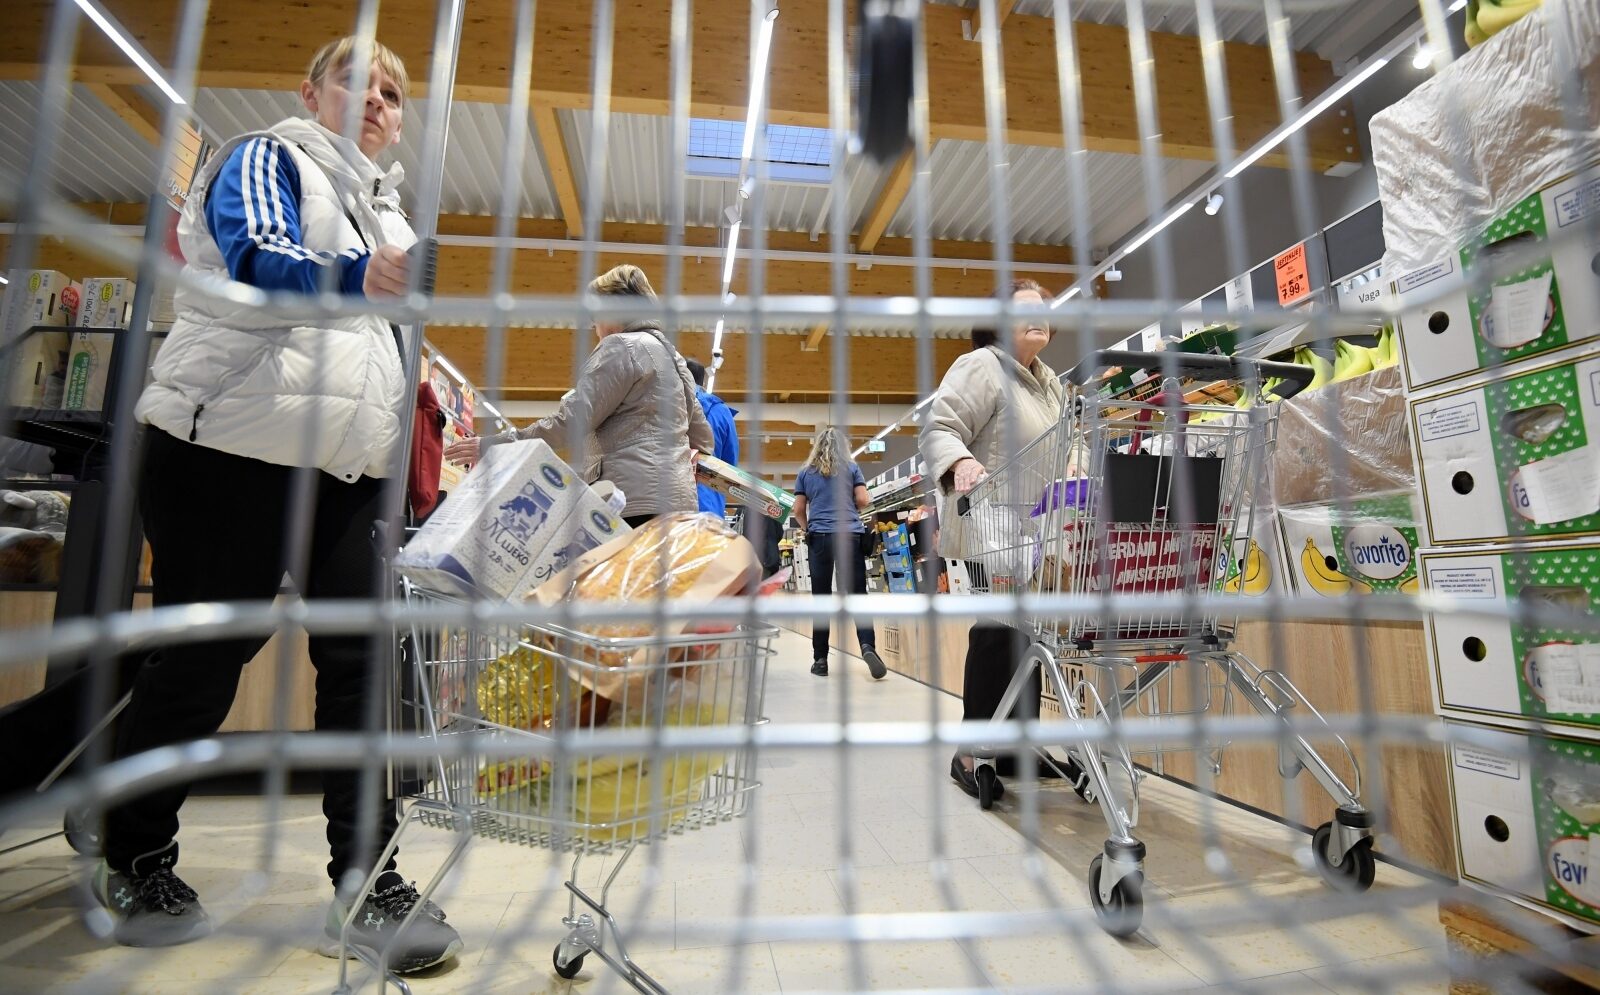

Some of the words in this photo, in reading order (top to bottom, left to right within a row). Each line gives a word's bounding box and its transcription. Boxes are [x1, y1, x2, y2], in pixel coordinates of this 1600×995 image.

[1281, 282, 1300, 300] 7.99
[1358, 289, 1380, 303] Vaga
[1350, 540, 1406, 567] favorita
